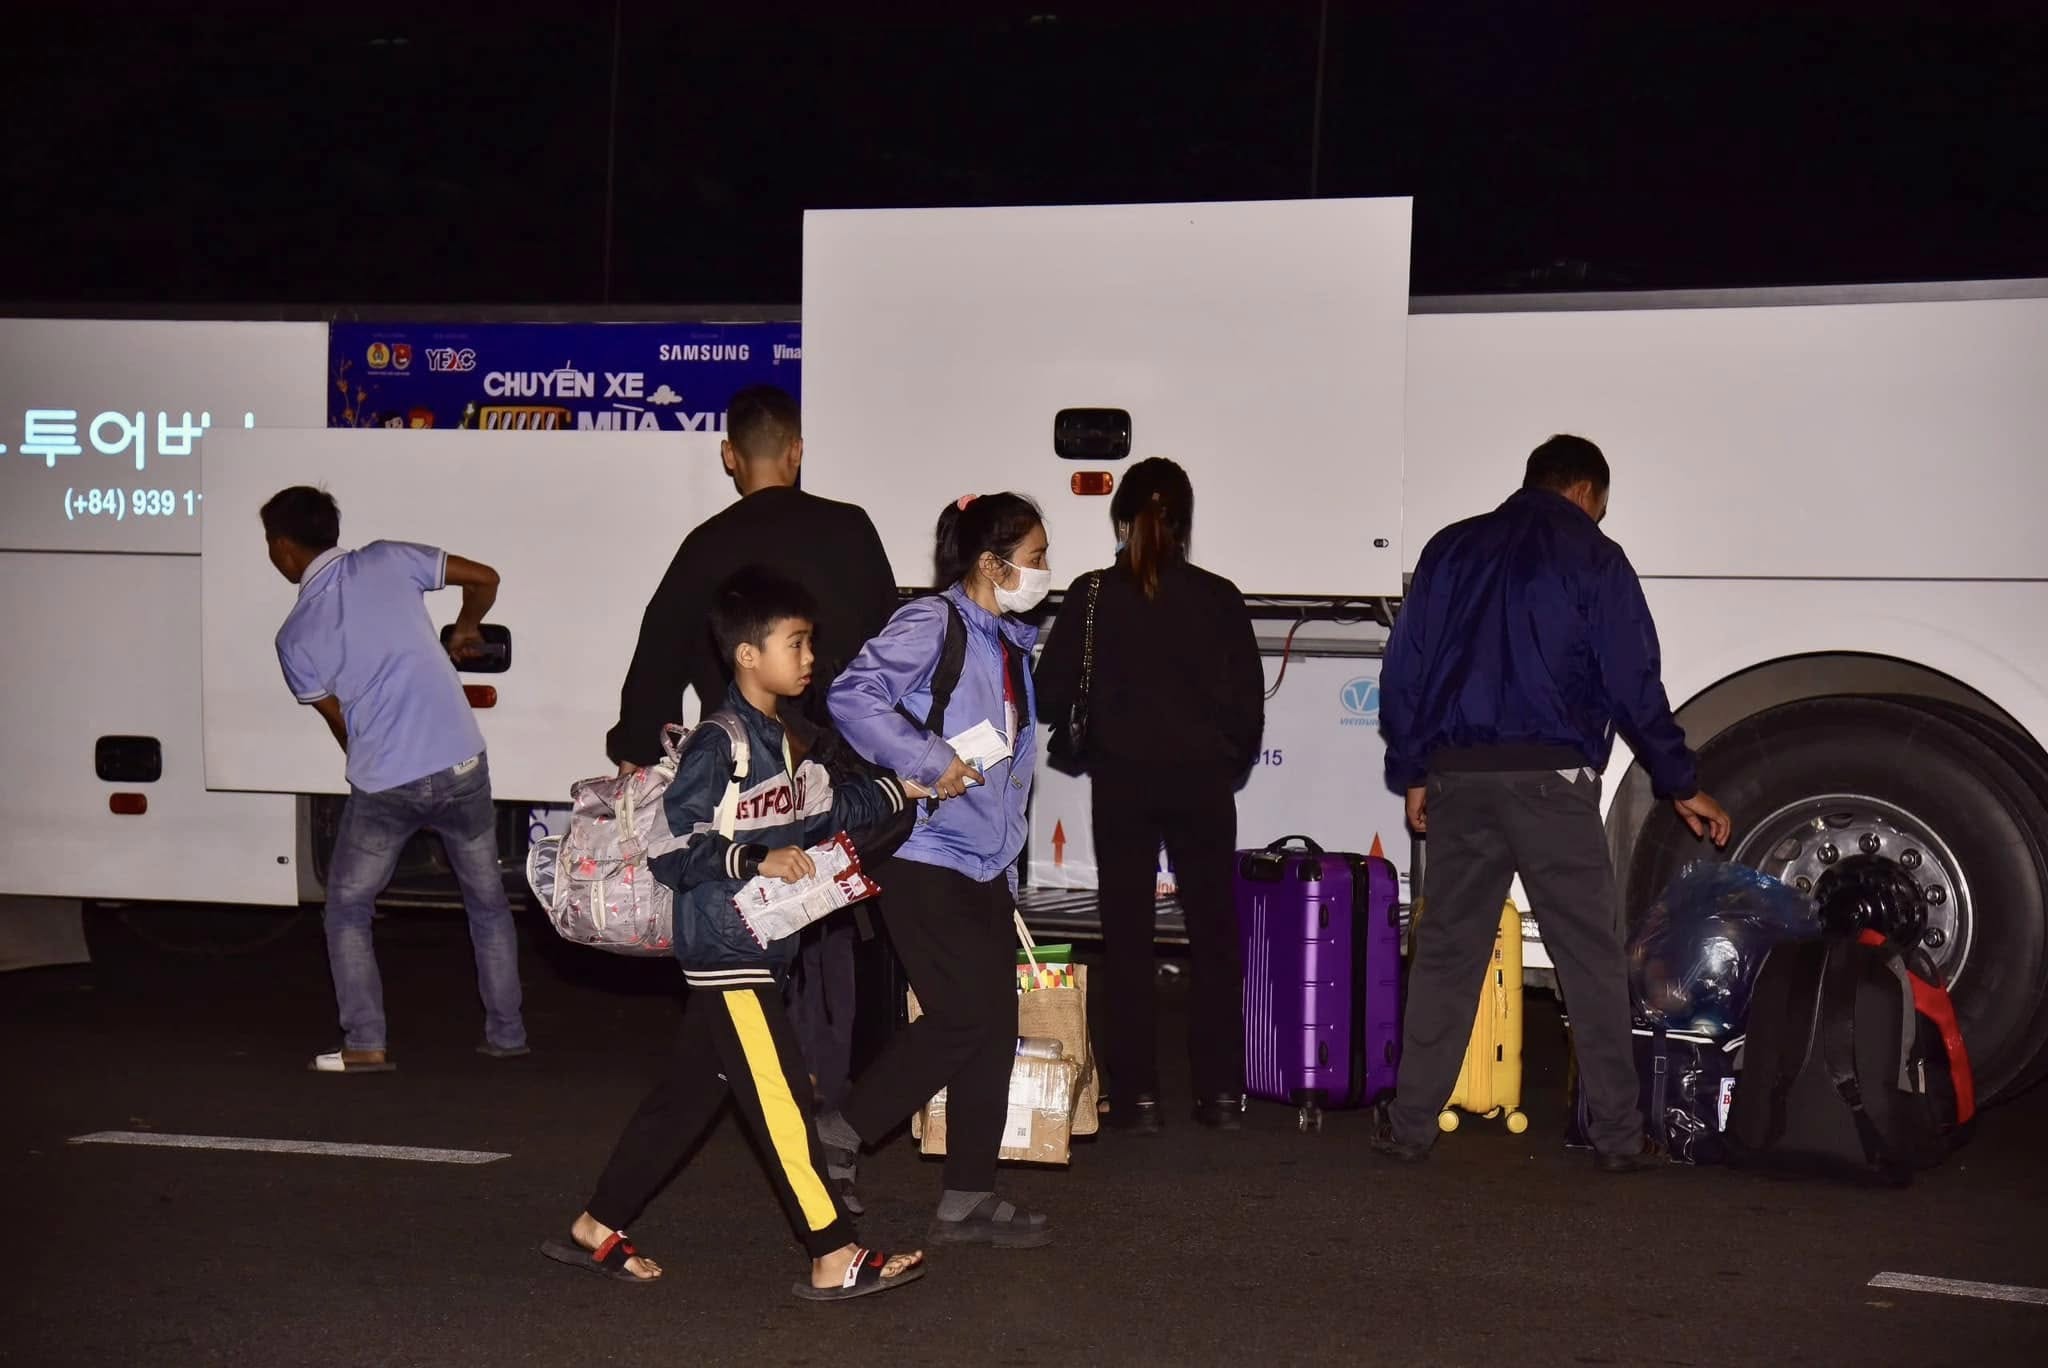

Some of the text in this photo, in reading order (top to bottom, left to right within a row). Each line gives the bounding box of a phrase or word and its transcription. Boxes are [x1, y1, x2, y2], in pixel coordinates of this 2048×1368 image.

[659, 344, 750, 361] SAMSUNG
[773, 344, 802, 359] Vina
[483, 359, 644, 397] CHUYẾN XE
[64, 487, 202, 520] (+84) 939 1
